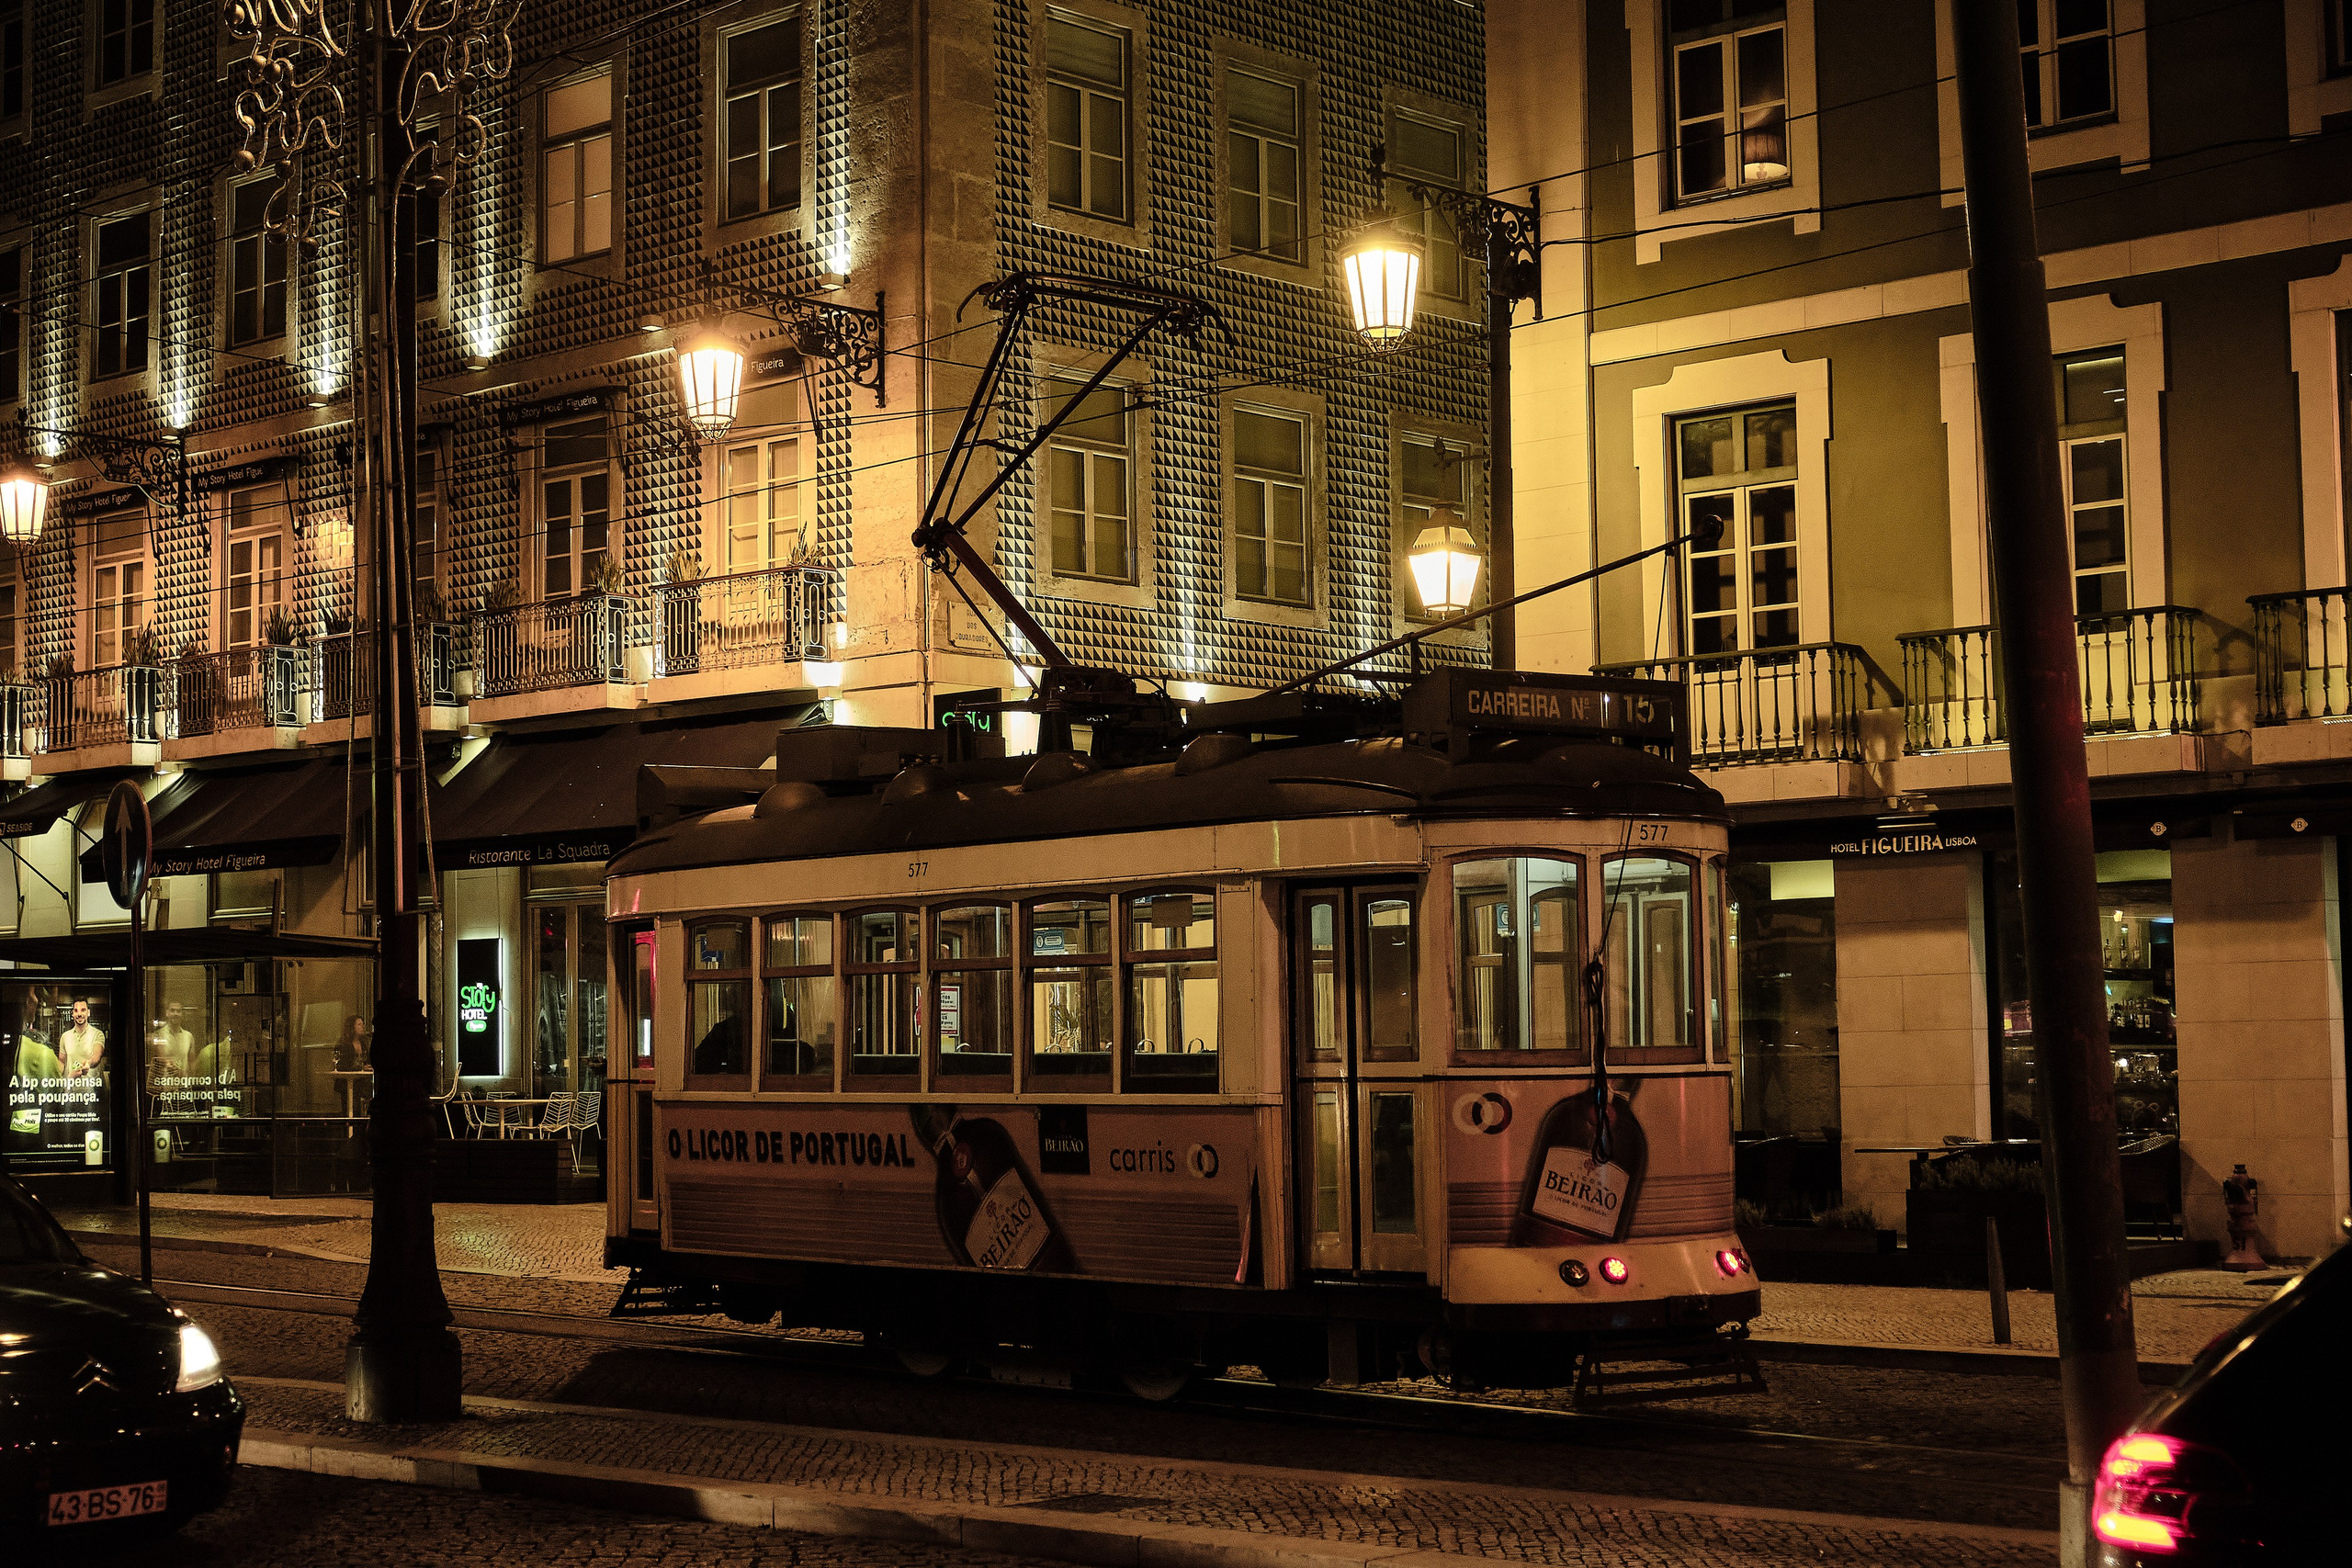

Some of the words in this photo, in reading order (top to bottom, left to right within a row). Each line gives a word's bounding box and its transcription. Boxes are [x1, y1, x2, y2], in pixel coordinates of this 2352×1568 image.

[751, 358, 785, 374] Figueira
[506, 411, 519, 423] My
[520, 406, 541, 419] Story
[543, 400, 563, 413] Hotel
[566, 395, 598, 411] Figueira
[198, 476, 209, 489] My
[210, 472, 227, 485] Story
[228, 468, 244, 480] Hotel
[78, 500, 93, 513] Story
[95, 496, 110, 508] Hotel
[111, 492, 132, 505] Figueir
[1467, 689, 1561, 719] CARREIRA
[1623, 694, 1655, 724] 15
[6, 822, 33, 833] SEASIDE
[1639, 824, 1668, 841] 577
[469, 849, 531, 865] Ristorante
[537, 845, 553, 860] La
[558, 840, 611, 862] Squadra
[1830, 842, 1860, 854] HOTEL
[1861, 834, 1944, 855] FIGUEIRA
[1945, 836, 1977, 847] LISBOA
[165, 859, 193, 874] Story
[196, 855, 223, 871] Hotel
[226, 852, 266, 872] Figueira
[908, 862, 929, 878] 577
[461, 1009, 488, 1021] HOTEL
[8, 1075, 19, 1088] A
[22, 1076, 39, 1090] bp
[40, 1077, 103, 1090] compensa
[9, 1090, 35, 1106] pela
[38, 1092, 99, 1106] poupança.
[668, 1129, 681, 1159] O
[687, 1129, 750, 1163] LICOR
[755, 1131, 784, 1164] DE
[790, 1132, 916, 1168] PORTUGAL
[1045, 1136, 1084, 1154] BEIRÃO
[1109, 1140, 1176, 1173] carris
[1544, 1170, 1618, 1211] BEIRÃO
